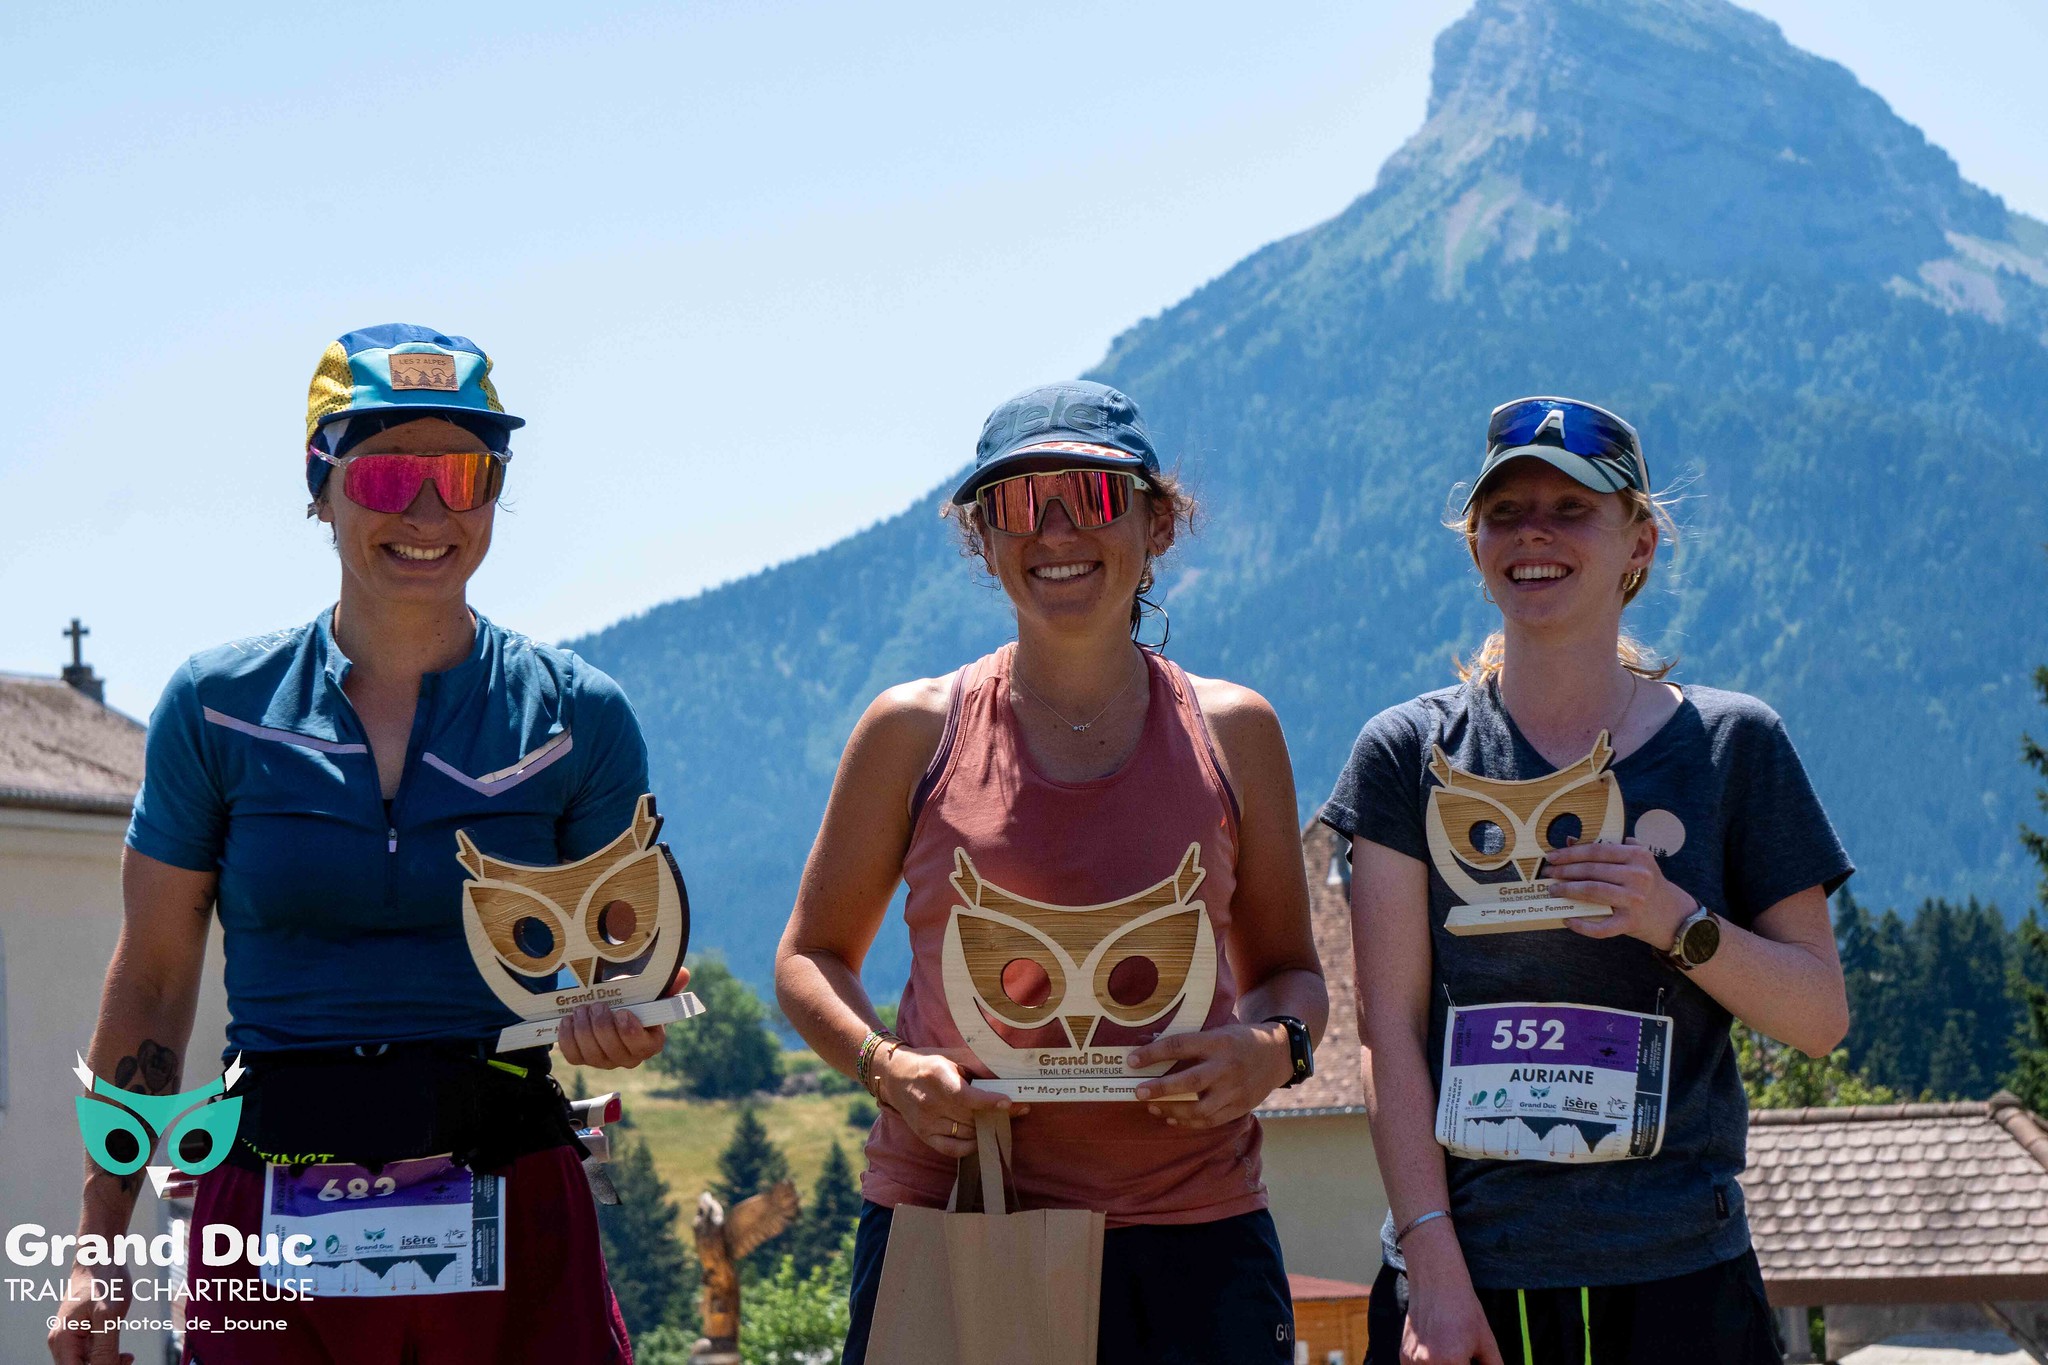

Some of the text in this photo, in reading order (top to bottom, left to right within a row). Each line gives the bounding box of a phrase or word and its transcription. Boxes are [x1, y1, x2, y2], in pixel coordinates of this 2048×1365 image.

[1499, 884, 1535, 896] Grand
[1498, 907, 1527, 916] Moyen
[1545, 904, 1575, 912] Femme
[555, 988, 595, 1007] Grand
[596, 987, 622, 1000] Duc
[1491, 1019, 1566, 1051] 552
[1039, 1052, 1123, 1067] Grand Duc
[1039, 1067, 1124, 1076] TRAIL DE CHARTREUSE
[1509, 1068, 1595, 1085] AURIANE
[1037, 1085, 1077, 1096] Moyen
[1079, 1085, 1100, 1094] Duc
[1102, 1085, 1137, 1094] Femm
[1519, 1101, 1542, 1109] Grand
[1543, 1102, 1557, 1110] Duc
[1564, 1096, 1598, 1111] isère
[401, 1235, 436, 1247] isère
[354, 1243, 379, 1252] Grand
